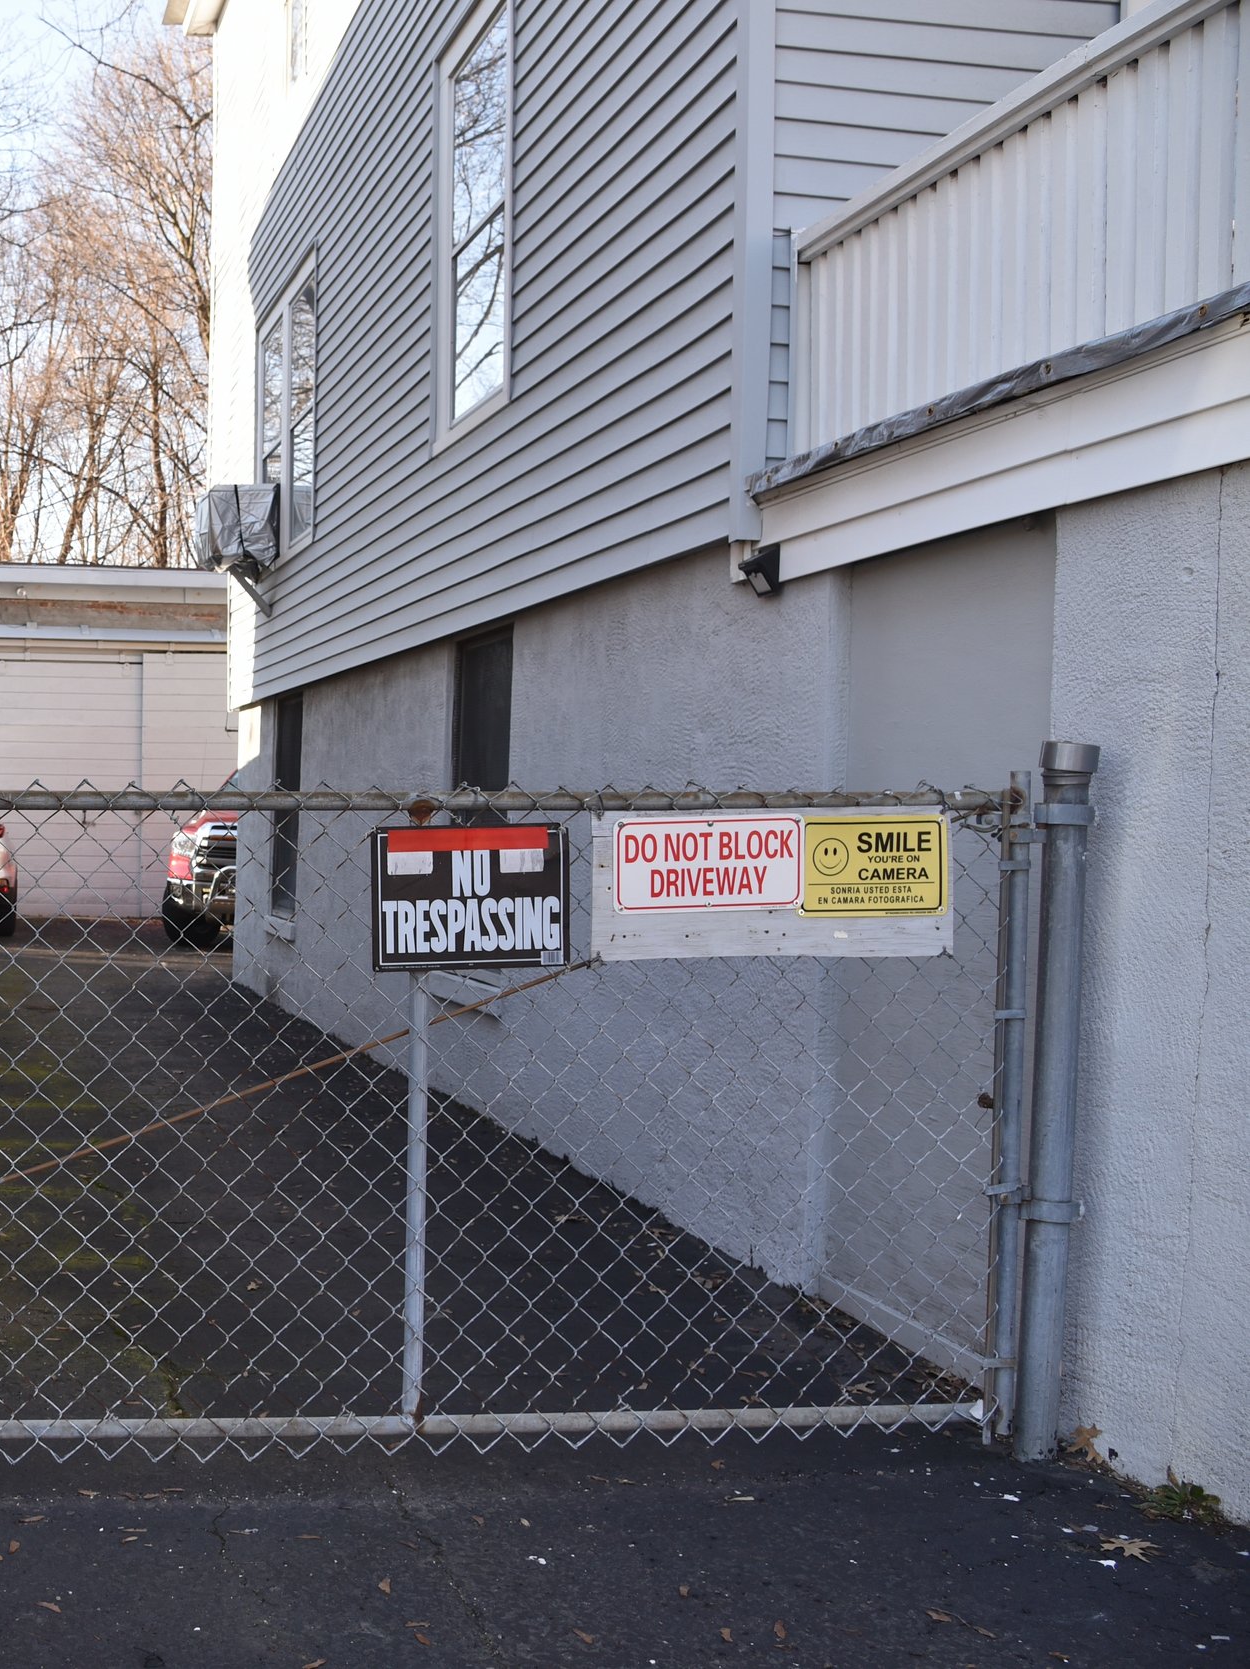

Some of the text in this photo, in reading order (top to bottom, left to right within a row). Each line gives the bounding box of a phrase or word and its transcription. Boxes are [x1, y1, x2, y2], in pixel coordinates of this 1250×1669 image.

[625, 830, 793, 864] DO NOT BLOCK
[857, 831, 931, 853] SMILE
[867, 854, 920, 864] YOU'RE ON
[452, 849, 491, 897] NO
[650, 865, 768, 898] DRIVEWAY
[857, 867, 929, 881] CAMERA
[817, 895, 925, 905] EN CAMARA FOTOGRAFICA
[830, 885, 912, 895] SONRIA USTED ESTA
[382, 896, 561, 954] TRESPASSING
